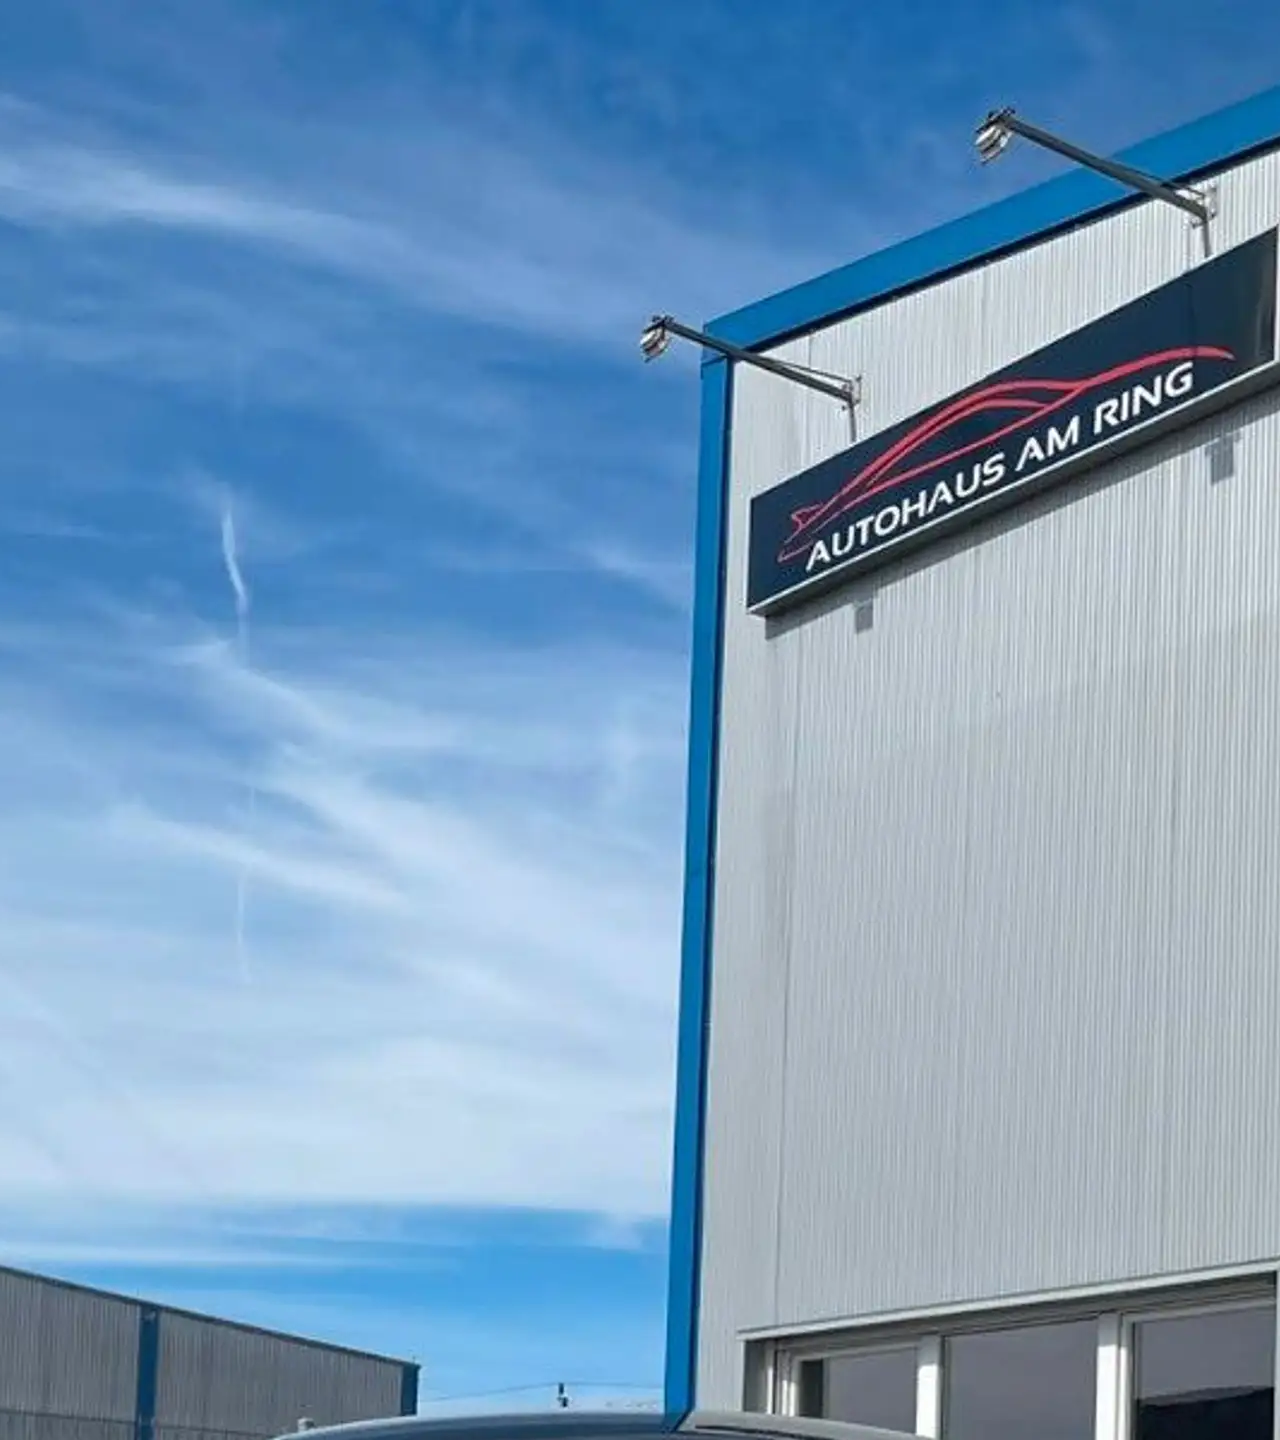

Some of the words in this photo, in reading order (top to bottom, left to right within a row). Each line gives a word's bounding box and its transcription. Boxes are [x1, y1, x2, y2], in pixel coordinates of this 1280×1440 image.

[805, 452, 1006, 571] AUTOHAUS
[1014, 415, 1080, 472] AM
[1093, 361, 1194, 435] RING
